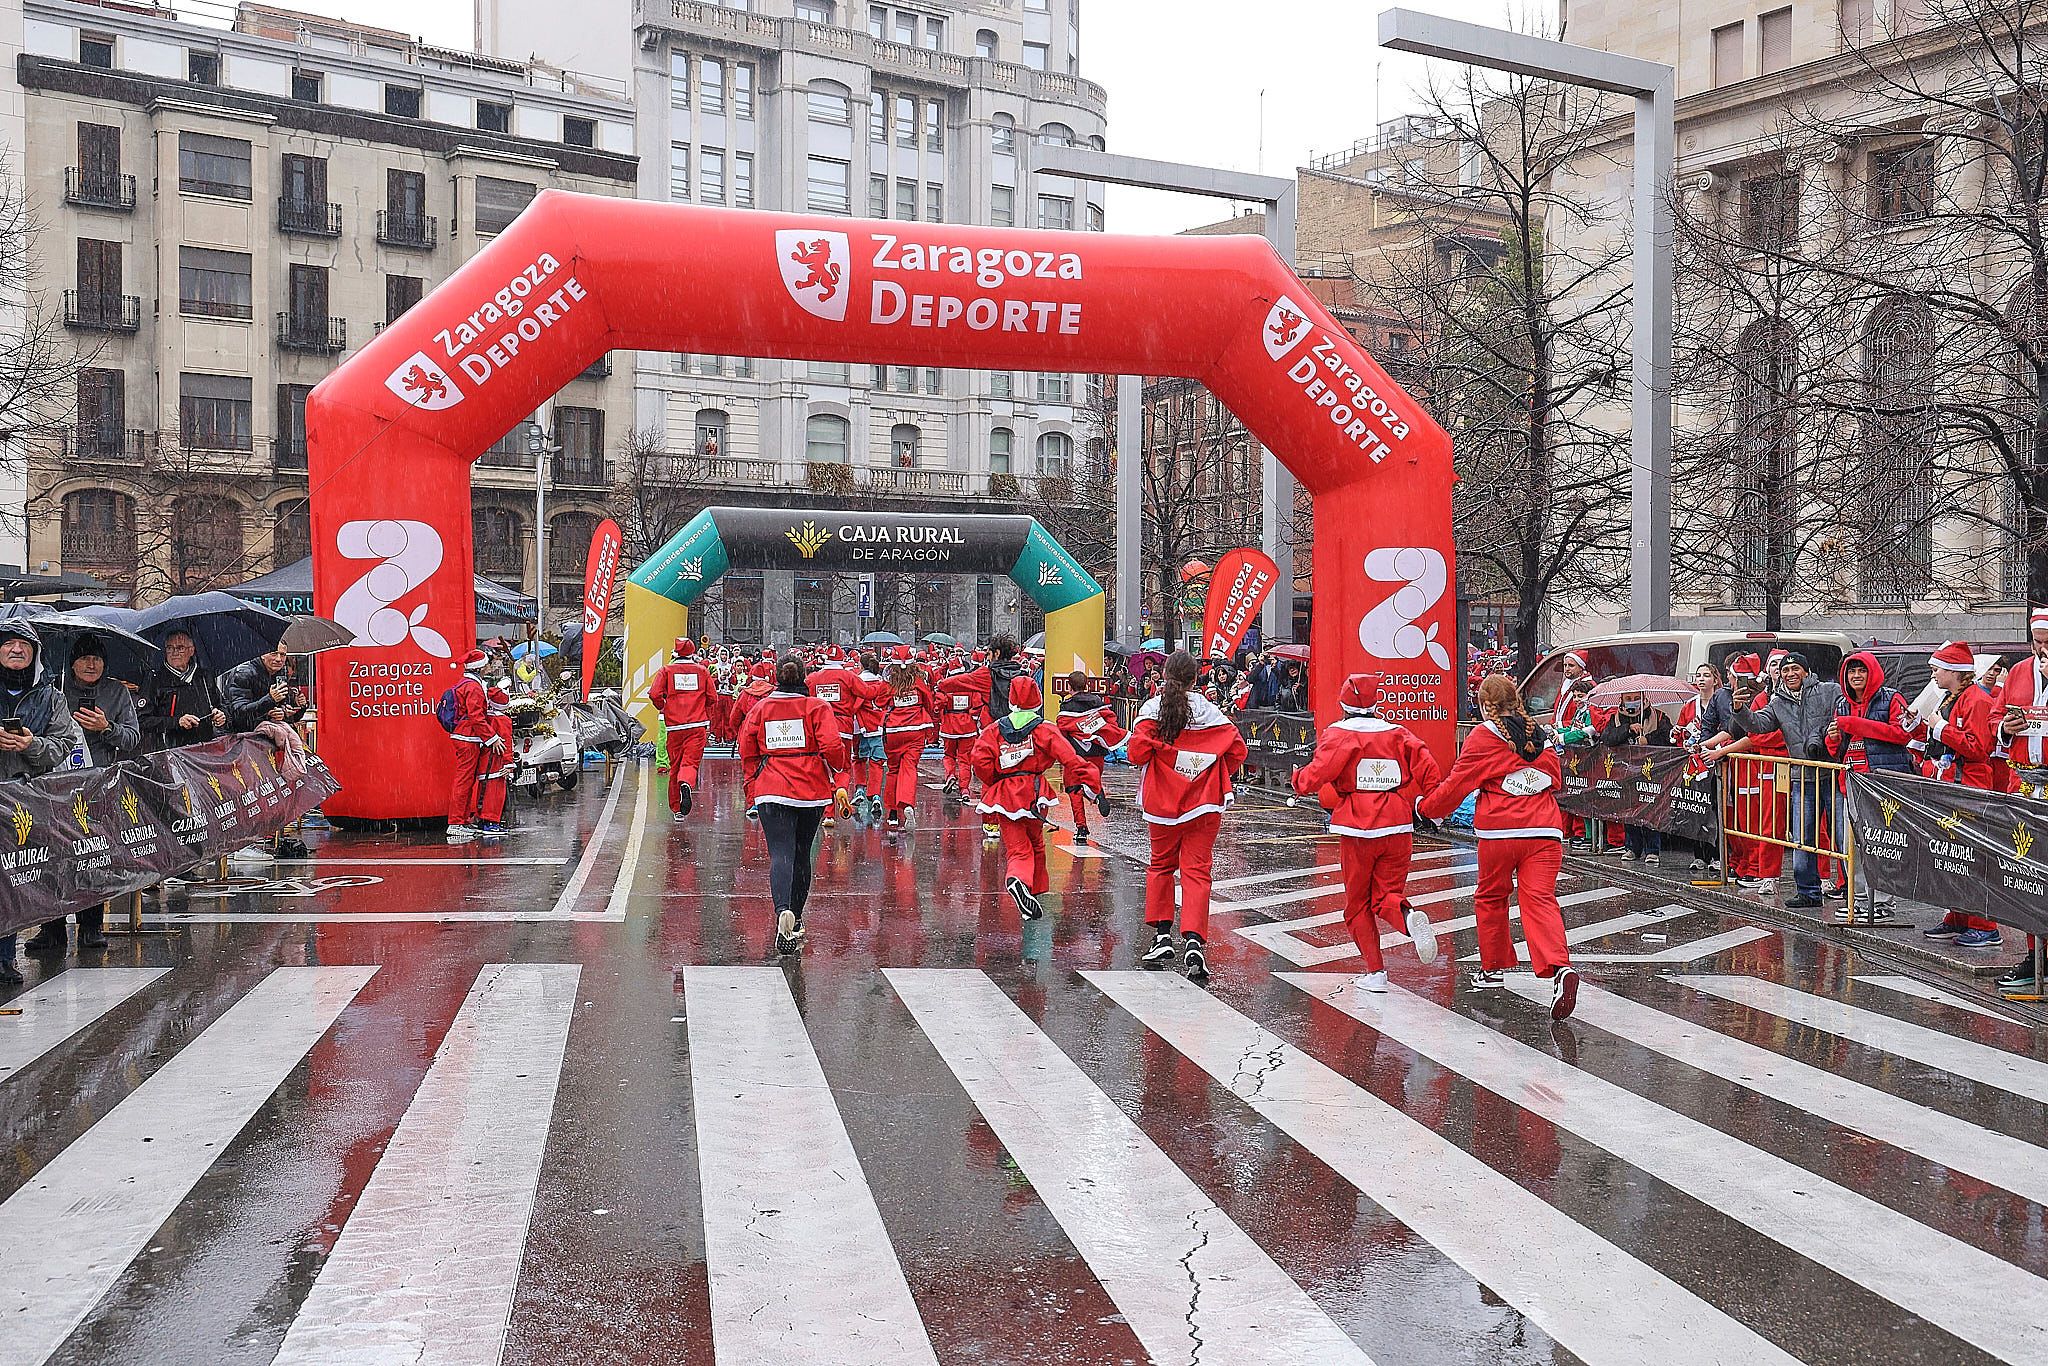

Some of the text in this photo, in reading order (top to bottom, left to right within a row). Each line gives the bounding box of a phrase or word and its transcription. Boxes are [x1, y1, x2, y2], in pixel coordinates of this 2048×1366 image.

[870, 233, 1083, 289] Zaragoza
[432, 252, 561, 358] Zaragoza
[869, 279, 1082, 335] DEPORTE
[458, 276, 588, 386] DEPORTE
[1311, 335, 1411, 441] Zaragoza
[1286, 354, 1392, 464] DEPORTE
[838, 525, 966, 544] CAJA RURAL
[642, 521, 712, 584] cajaruraldearagon.es
[852, 546, 950, 560] DE ARAGÓN
[1033, 530, 1095, 593] cajaruraldearagon.es
[587, 533, 611, 603] Zaragoza
[595, 539, 618, 611] DEPORTE
[1218, 562, 1254, 630] Zaragoza
[1225, 570, 1270, 637] DEPORTE
[348, 661, 433, 681] Zaragoza
[1374, 671, 1441, 689] Zaragoza
[350, 680, 423, 701] Deporte
[1376, 688, 1436, 707] Deporte
[1375, 705, 1448, 721] Sostenible
[1175, 766, 1192, 775] CAJA
[1358, 776, 1375, 784] CAJA
[1506, 778, 1523, 789] CAJA
[1684, 788, 1712, 805] RURAL
[1677, 801, 1707, 815] ARAGÓN
[1882, 830, 1909, 848] RURAL
[17, 845, 50, 867] RURAL
[1871, 845, 1903, 861] ARAGÓN
[1928, 839, 1976, 862] CAJA RURAL
[76, 859, 87, 872] DE
[1934, 858, 1970, 877] DE ARAGÓN
[2003, 875, 2044, 896] DE ARAGÓN
